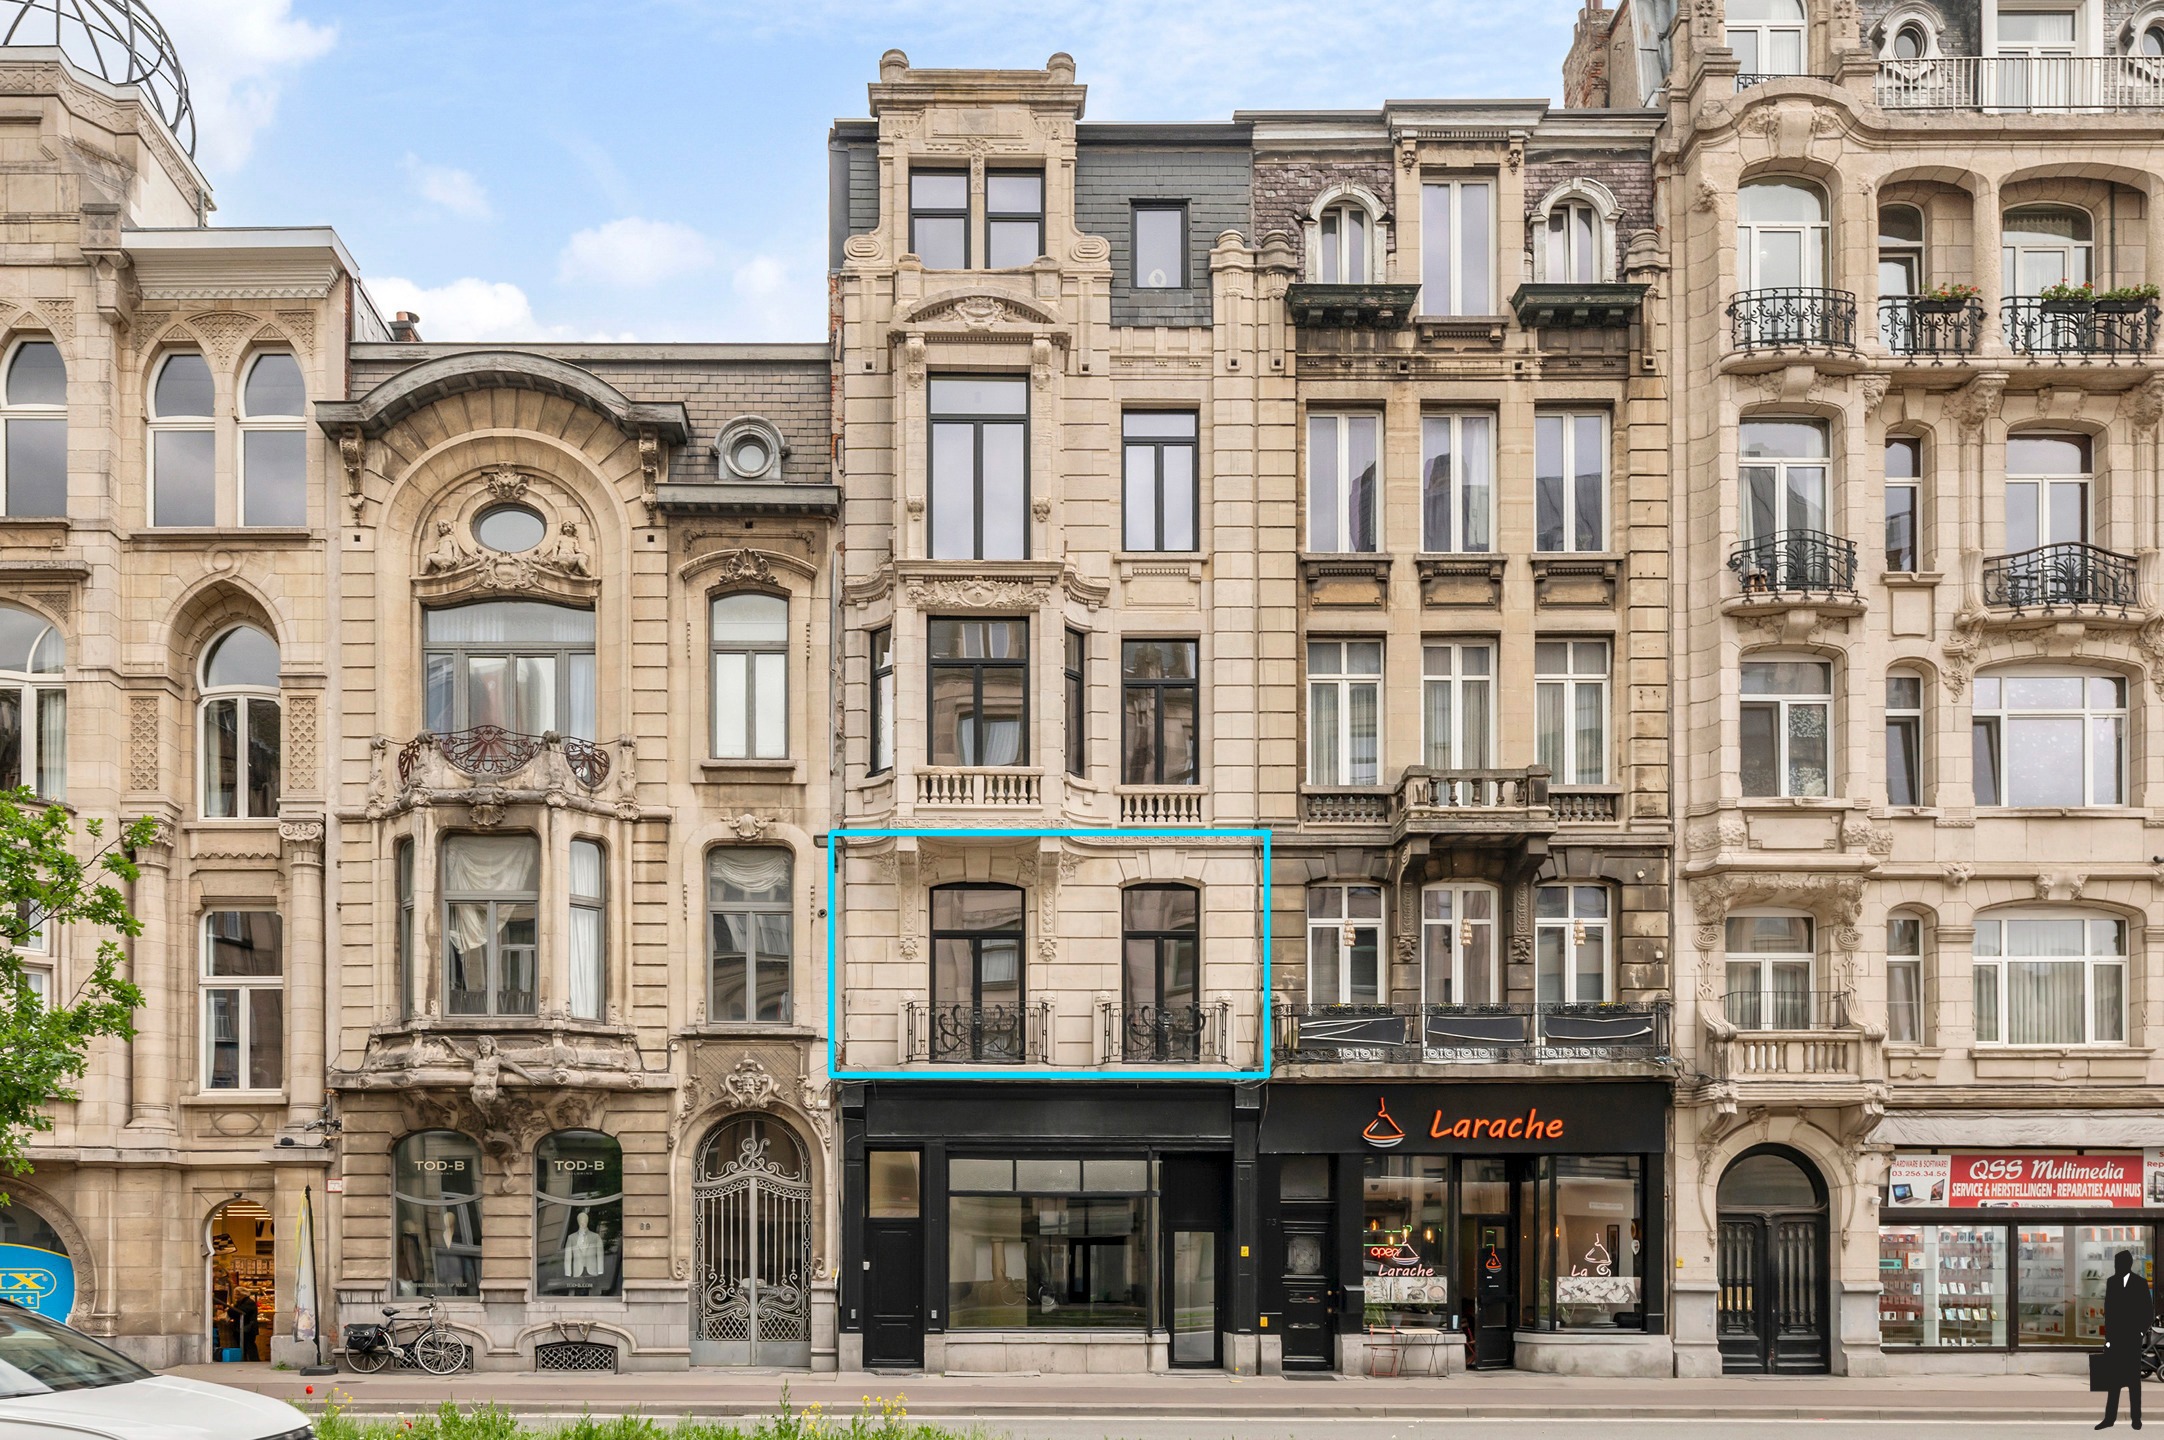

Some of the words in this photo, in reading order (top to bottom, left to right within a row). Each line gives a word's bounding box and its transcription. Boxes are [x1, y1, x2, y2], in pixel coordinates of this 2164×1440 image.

[1430, 1108, 1564, 1139] Larache
[414, 1161, 465, 1171] TOD-B
[554, 1161, 605, 1171] TOD-B
[1969, 1160, 2023, 1180] QSS
[2031, 1159, 2124, 1180] Multimedia
[1952, 1183, 1983, 1197] SERVICE
[1984, 1183, 1990, 1197] &
[1991, 1183, 2052, 1197] HERSTELLINGEN
[2057, 1183, 2103, 1197] REPARATIES
[2104, 1183, 2122, 1197] AAN
[2123, 1183, 2141, 1197] HUIS
[1378, 1264, 1434, 1277] Larache
